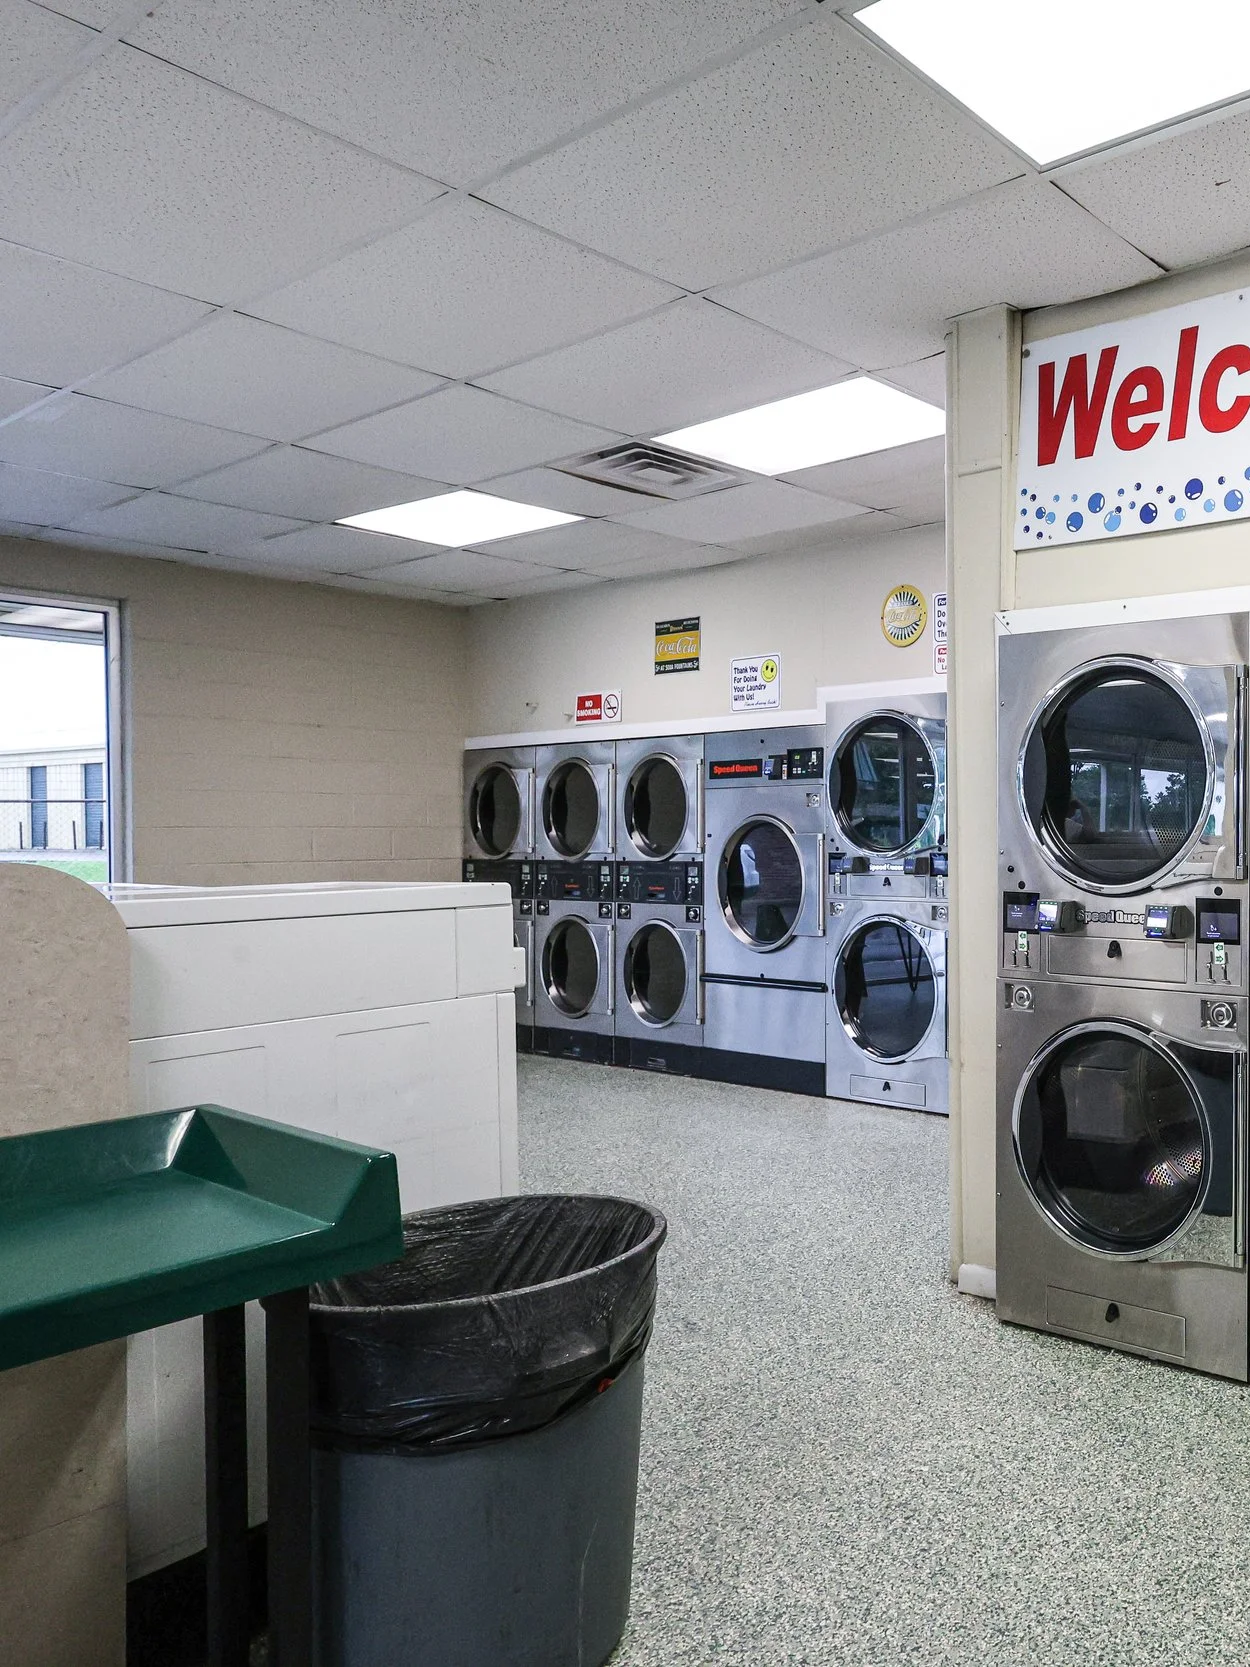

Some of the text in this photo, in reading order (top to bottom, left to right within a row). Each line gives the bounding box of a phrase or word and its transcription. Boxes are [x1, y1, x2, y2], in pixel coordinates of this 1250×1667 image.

[746, 683, 766, 691] Laundry
[585, 700, 593, 708] NO
[577, 708, 601, 717] SMOKING
[713, 764, 758, 775] Speed Queen
[1075, 909, 1145, 925] Speed Quee
